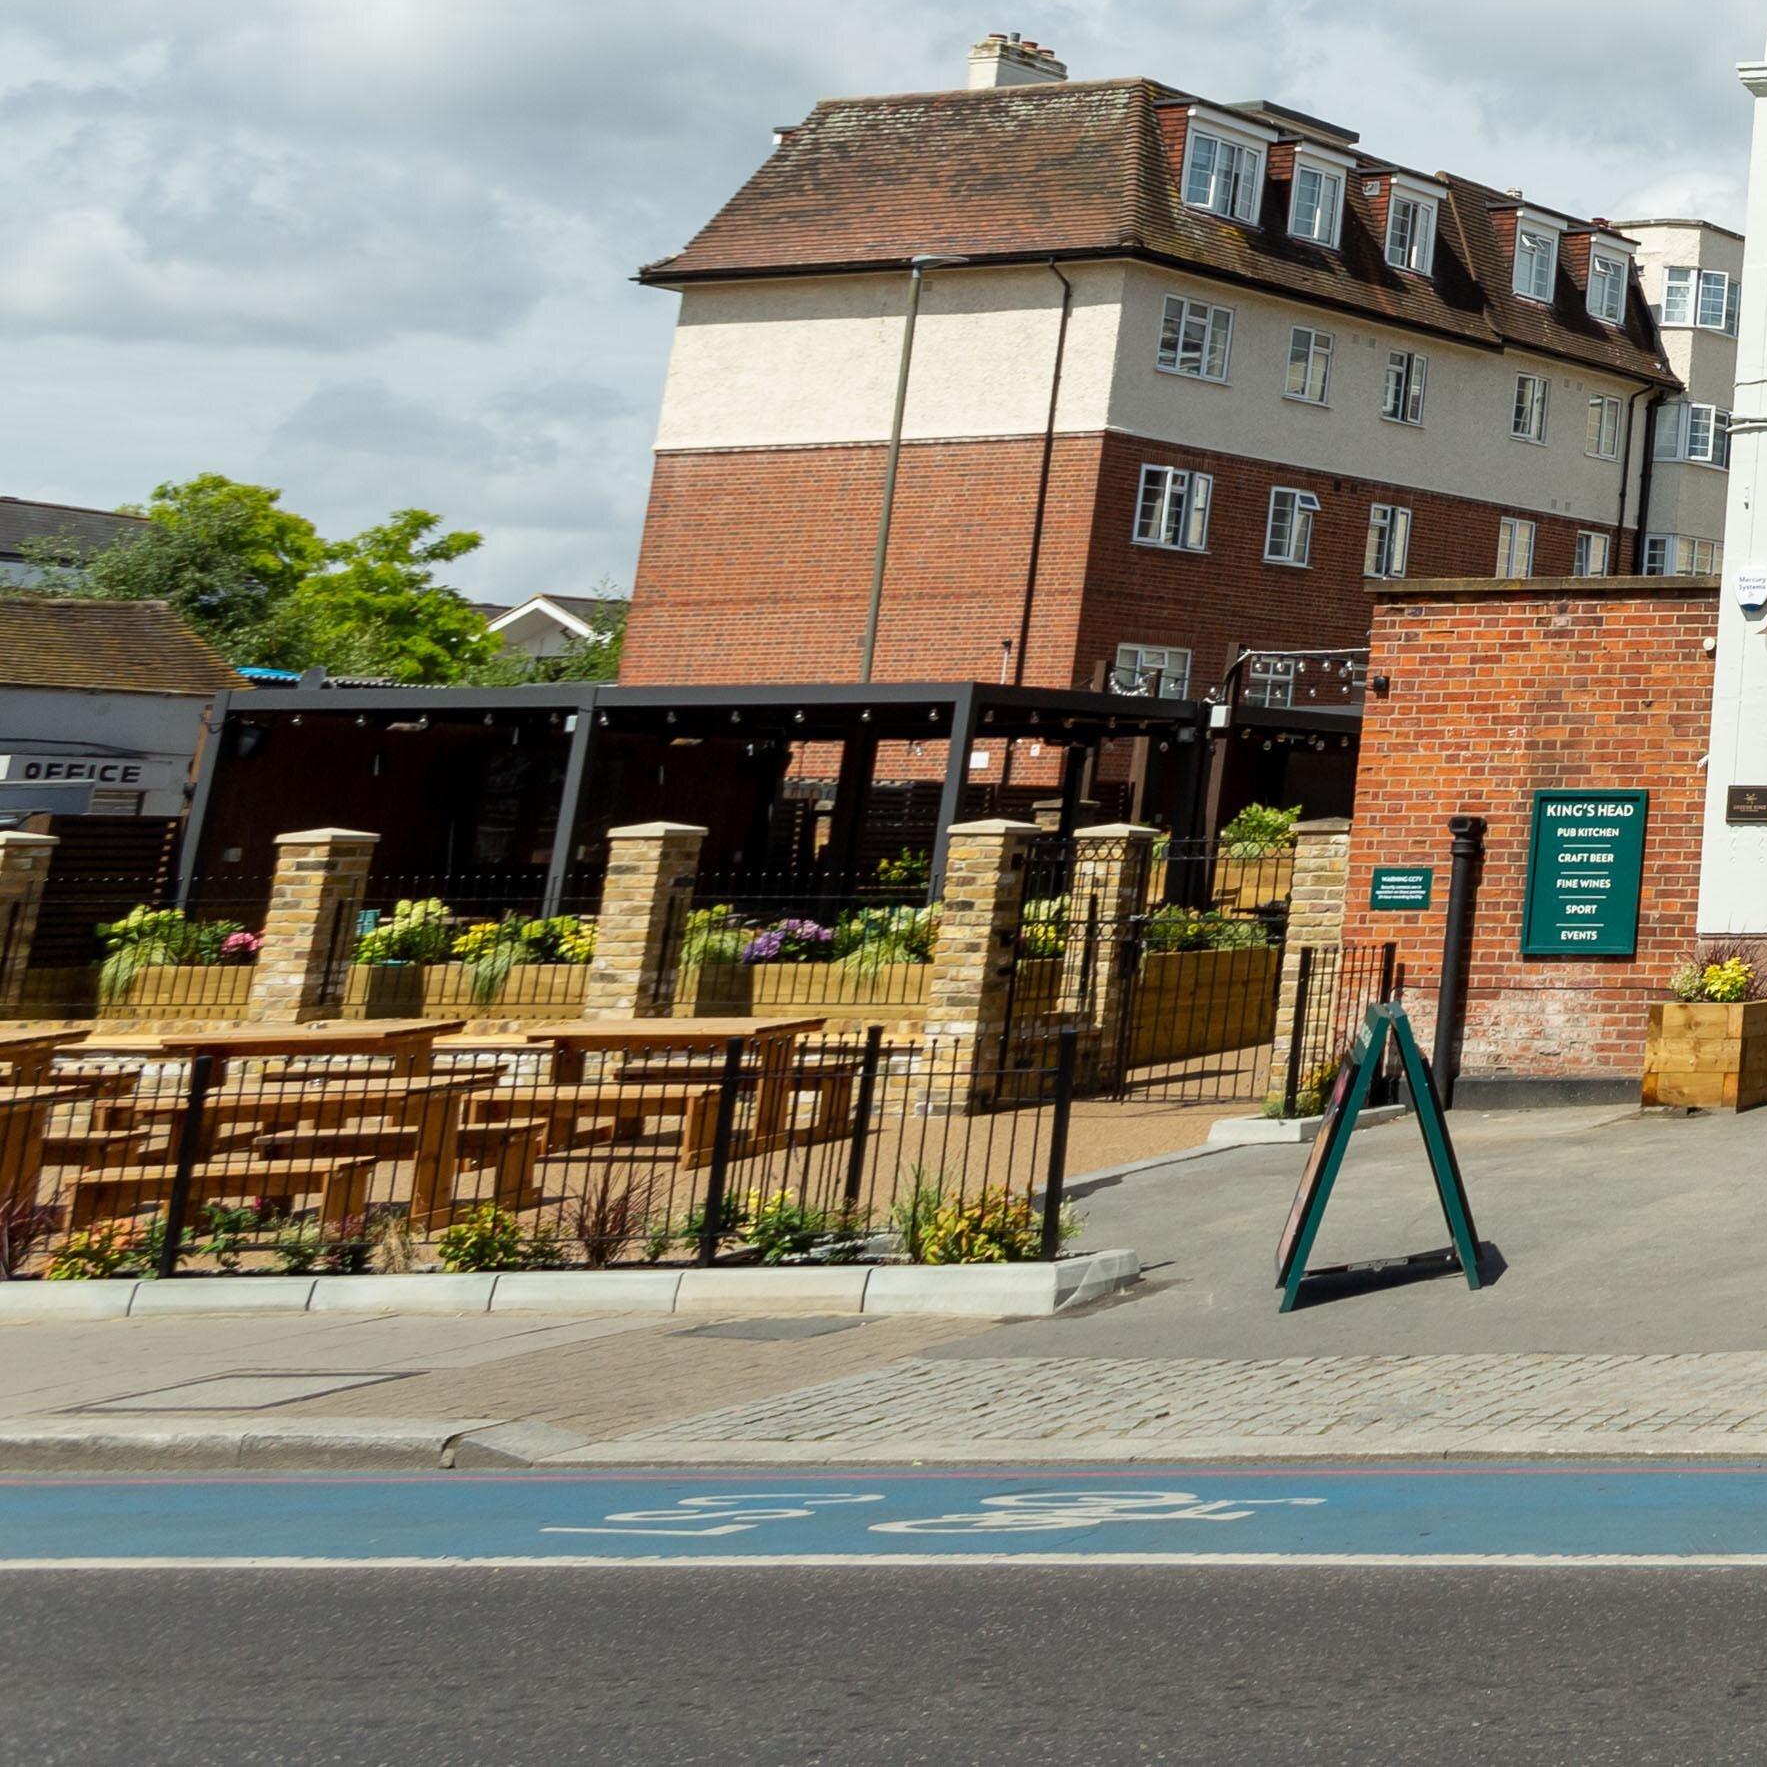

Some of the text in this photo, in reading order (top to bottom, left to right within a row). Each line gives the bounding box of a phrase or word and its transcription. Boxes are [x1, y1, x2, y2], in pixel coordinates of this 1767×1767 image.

[25, 761, 142, 783] OFFICE
[1546, 803, 1634, 817] KING'S HEAD
[1557, 827, 1620, 838] PUB KITCHEN
[1557, 852, 1615, 863] CRAFT BEER
[1556, 878, 1612, 889] FINE WINES
[1565, 904, 1599, 915] SPORT
[1560, 930, 1598, 941] EVENTS
